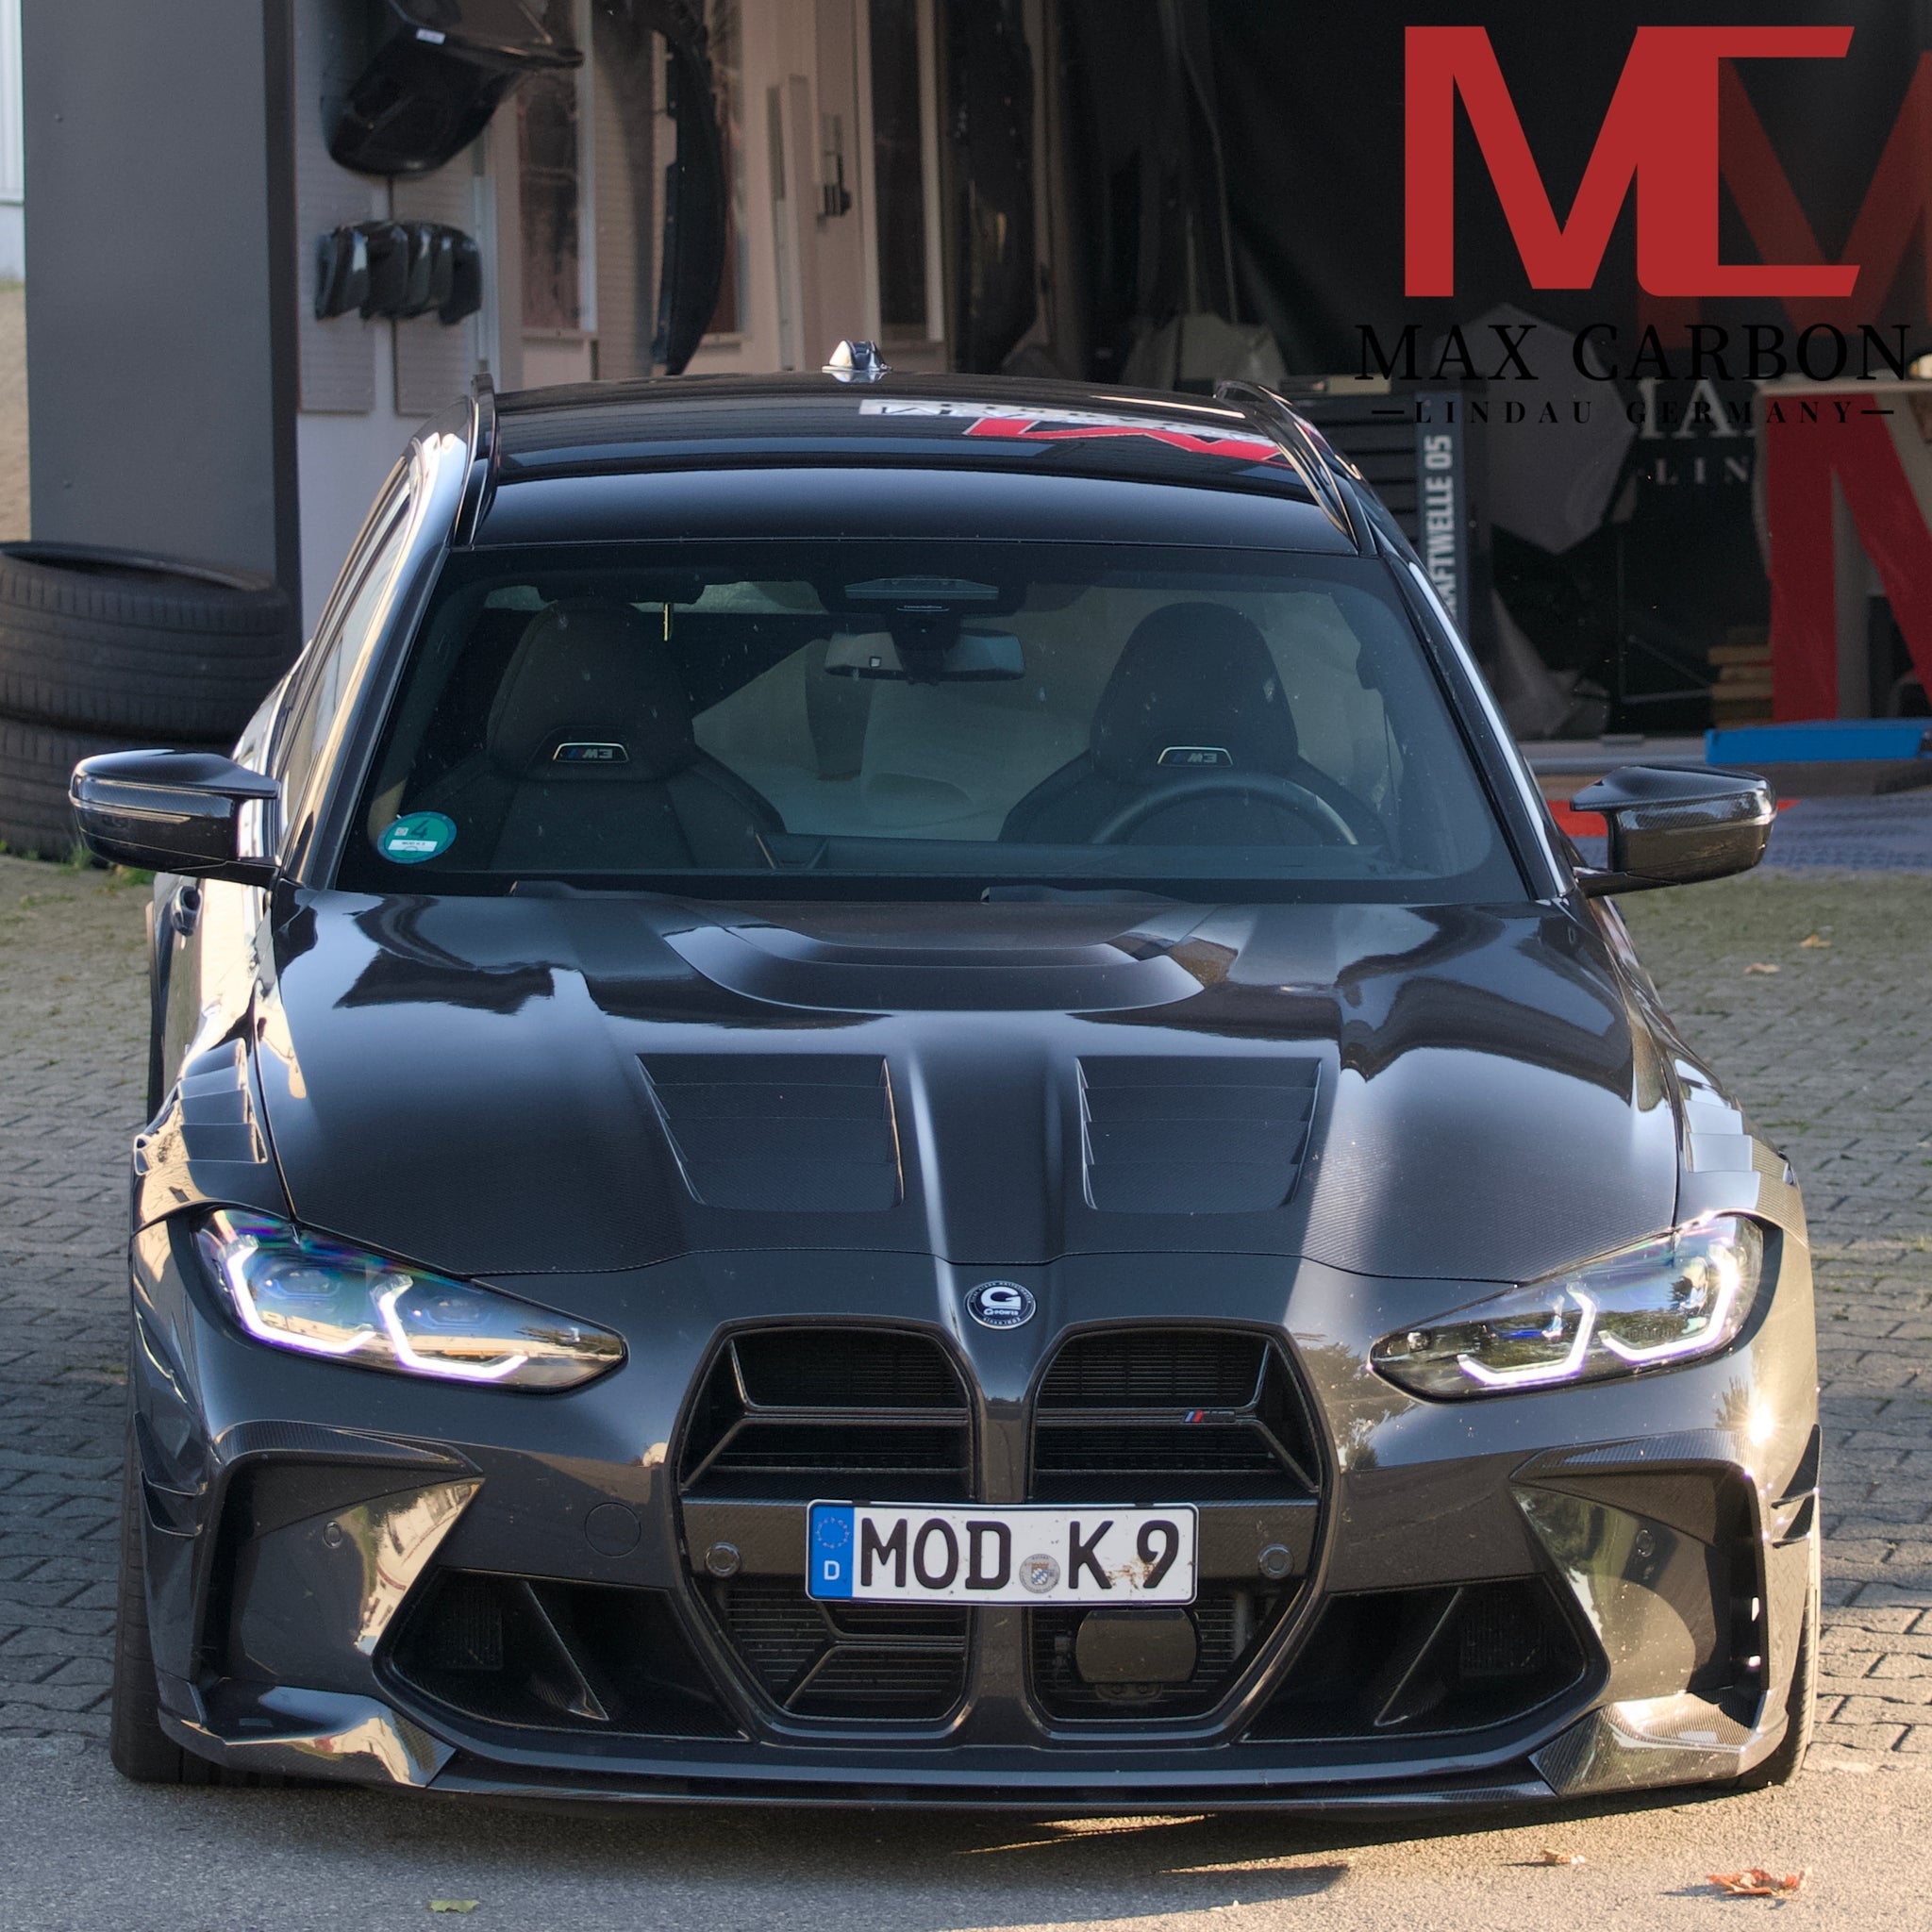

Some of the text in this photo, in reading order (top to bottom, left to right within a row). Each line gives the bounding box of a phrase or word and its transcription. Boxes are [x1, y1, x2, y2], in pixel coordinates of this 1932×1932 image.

[582, 748, 613, 758] M3
[1187, 753, 1218, 763] M3
[410, 819, 430, 839] 4
[860, 1517, 1012, 1591] MOD
[1069, 1520, 1114, 1591] K
[1136, 1520, 1180, 1591] 9
[823, 1560, 841, 1581] D
